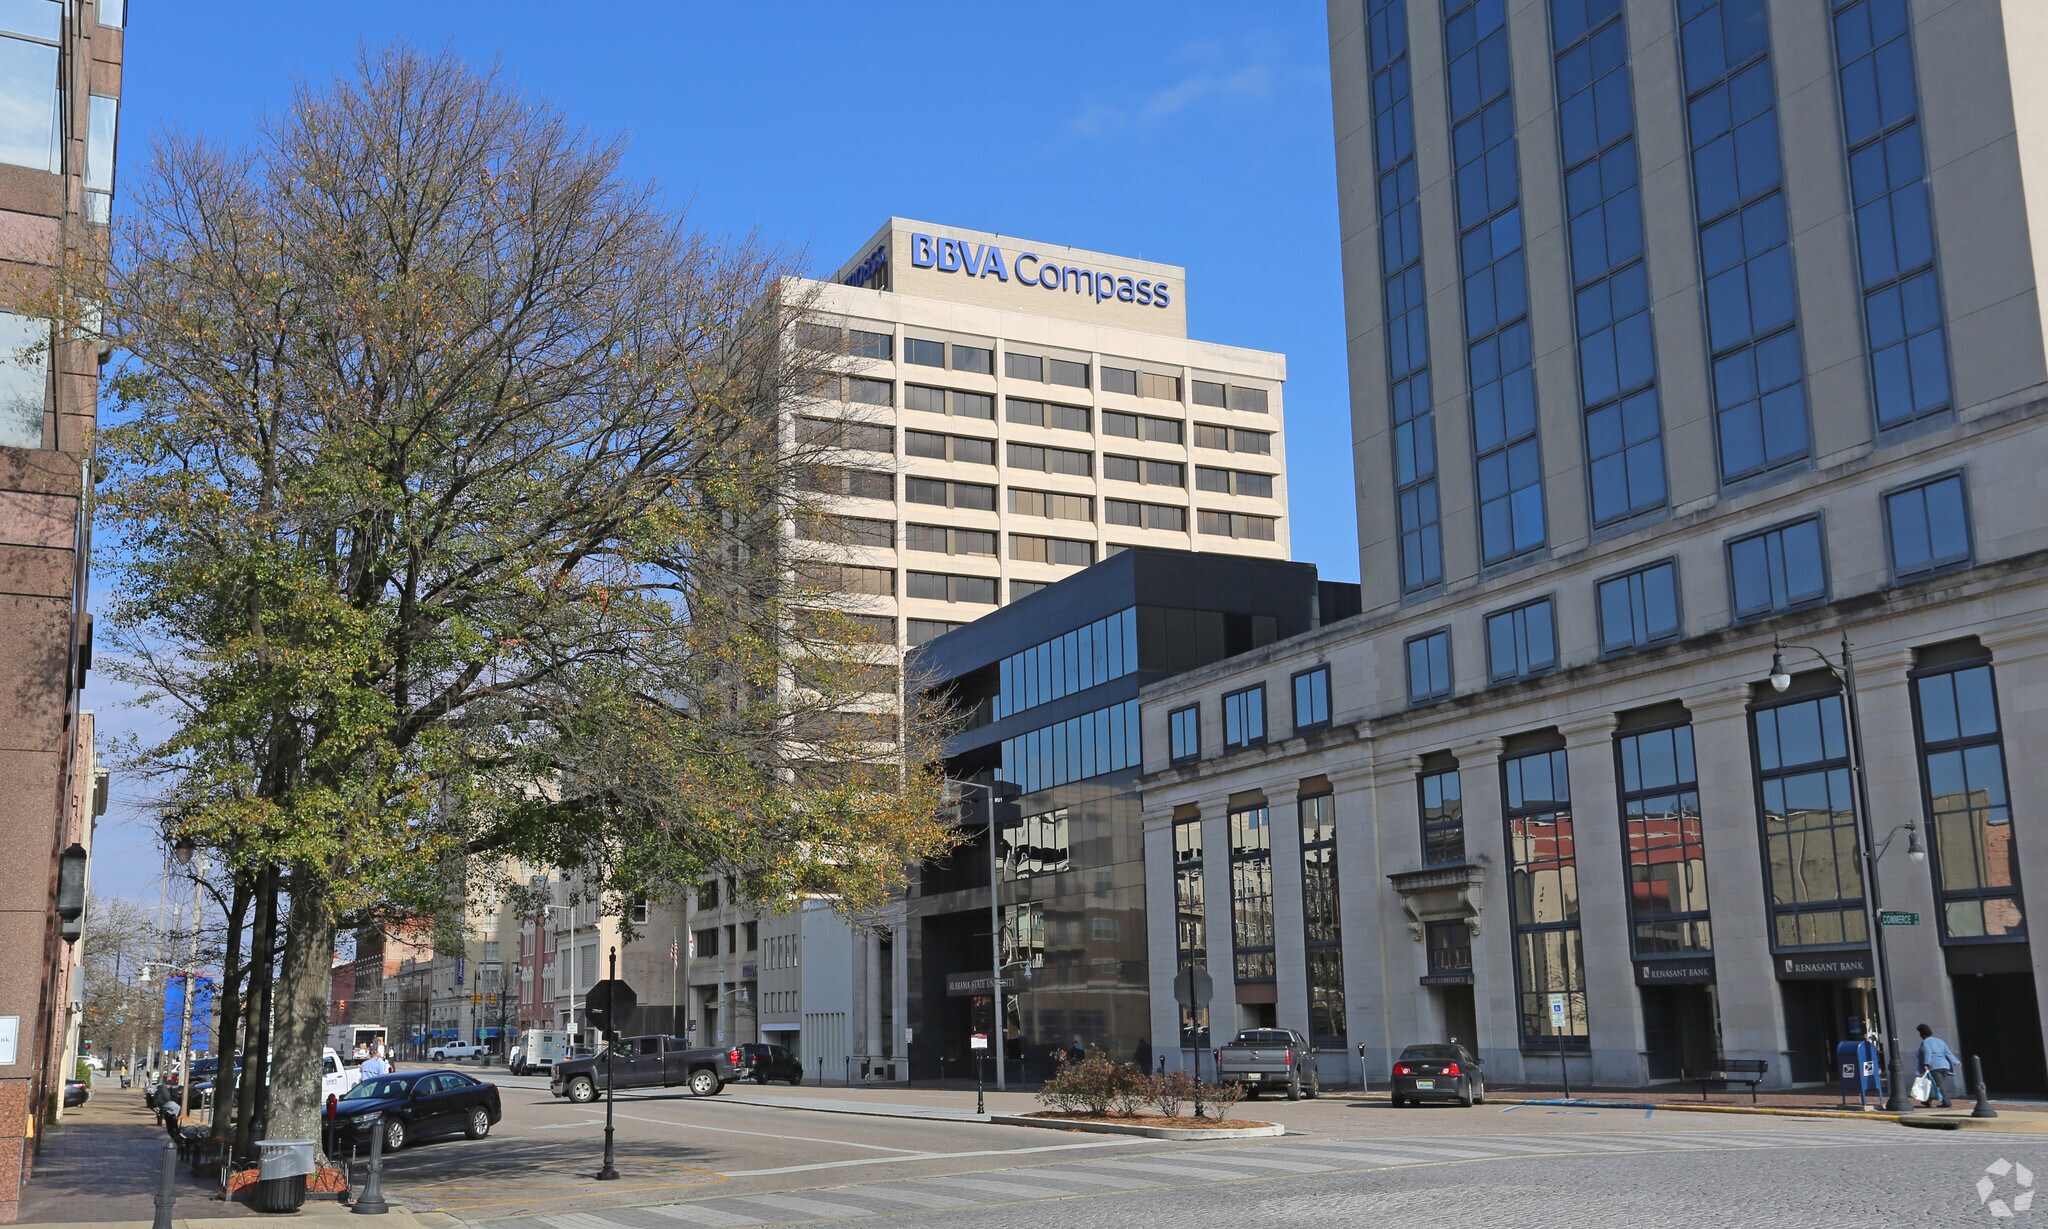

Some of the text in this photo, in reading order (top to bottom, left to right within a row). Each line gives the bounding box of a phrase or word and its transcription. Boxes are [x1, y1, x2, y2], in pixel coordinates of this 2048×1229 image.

[911, 232, 1171, 308] BBVA Compass
[1882, 914, 1912, 924] COMMERCE
[1795, 961, 1864, 972] RENASANT BANK
[1651, 968, 1709, 978] RENASANT BANK
[971, 979, 986, 989] STATE
